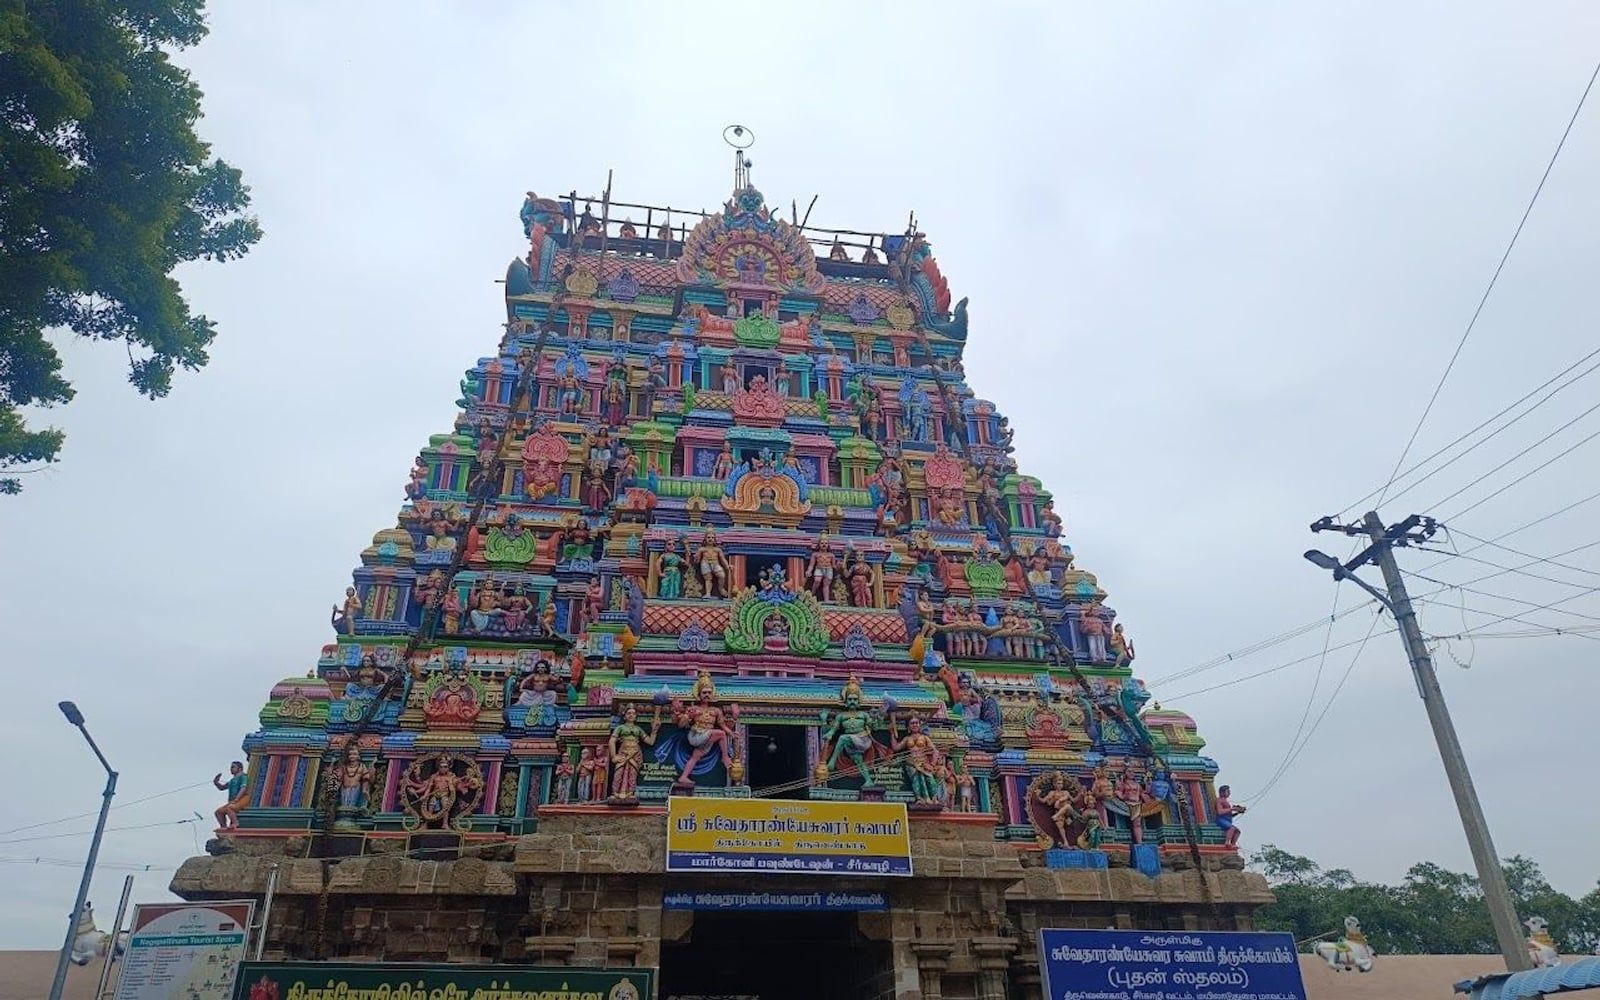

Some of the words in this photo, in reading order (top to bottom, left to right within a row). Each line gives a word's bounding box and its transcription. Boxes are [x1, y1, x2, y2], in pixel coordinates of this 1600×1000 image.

[854, 819, 902, 835] சுவாமி
[691, 856, 755, 868] மார்கோனி
[846, 858, 890, 872] சீர்காழி
[1140, 935, 1203, 946] அருள்மிகு
[1051, 944, 1170, 964] சுவேதாரண்யேசுவர
[1173, 946, 1215, 963] சுவாமி
[1217, 946, 1294, 966] திருக்கோயில்
[1108, 967, 1167, 989] (புதன்
[1172, 968, 1249, 989] ஸ்தலம்)
